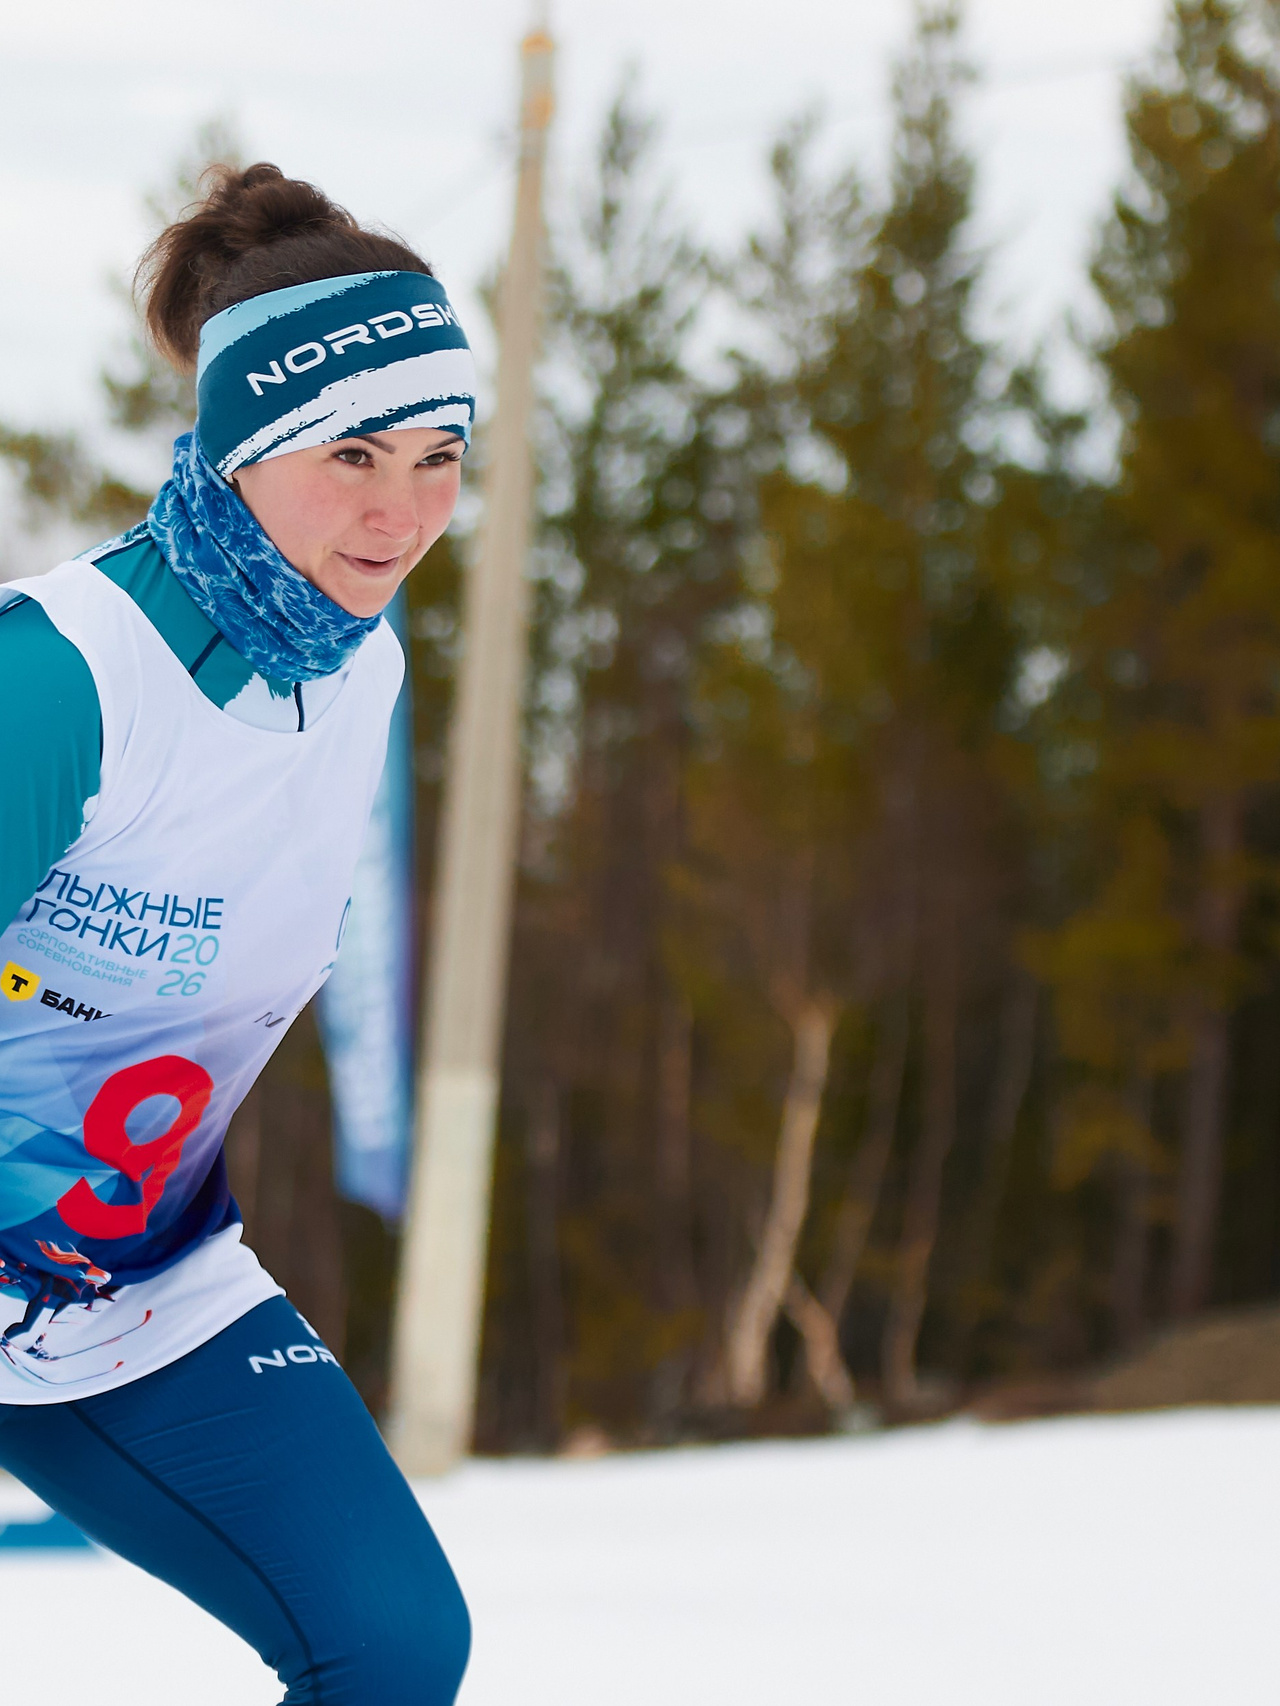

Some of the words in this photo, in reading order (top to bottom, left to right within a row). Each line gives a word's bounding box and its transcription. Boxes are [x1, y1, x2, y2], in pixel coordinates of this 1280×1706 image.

[36, 868, 224, 930] ЛЫЖНЫЕ
[17, 933, 133, 987] СОРЕВНОВАНИЯ
[25, 897, 171, 961] ГОНКИ
[170, 933, 220, 966] 20
[156, 969, 207, 997] 26
[56, 1054, 215, 1240] 9
